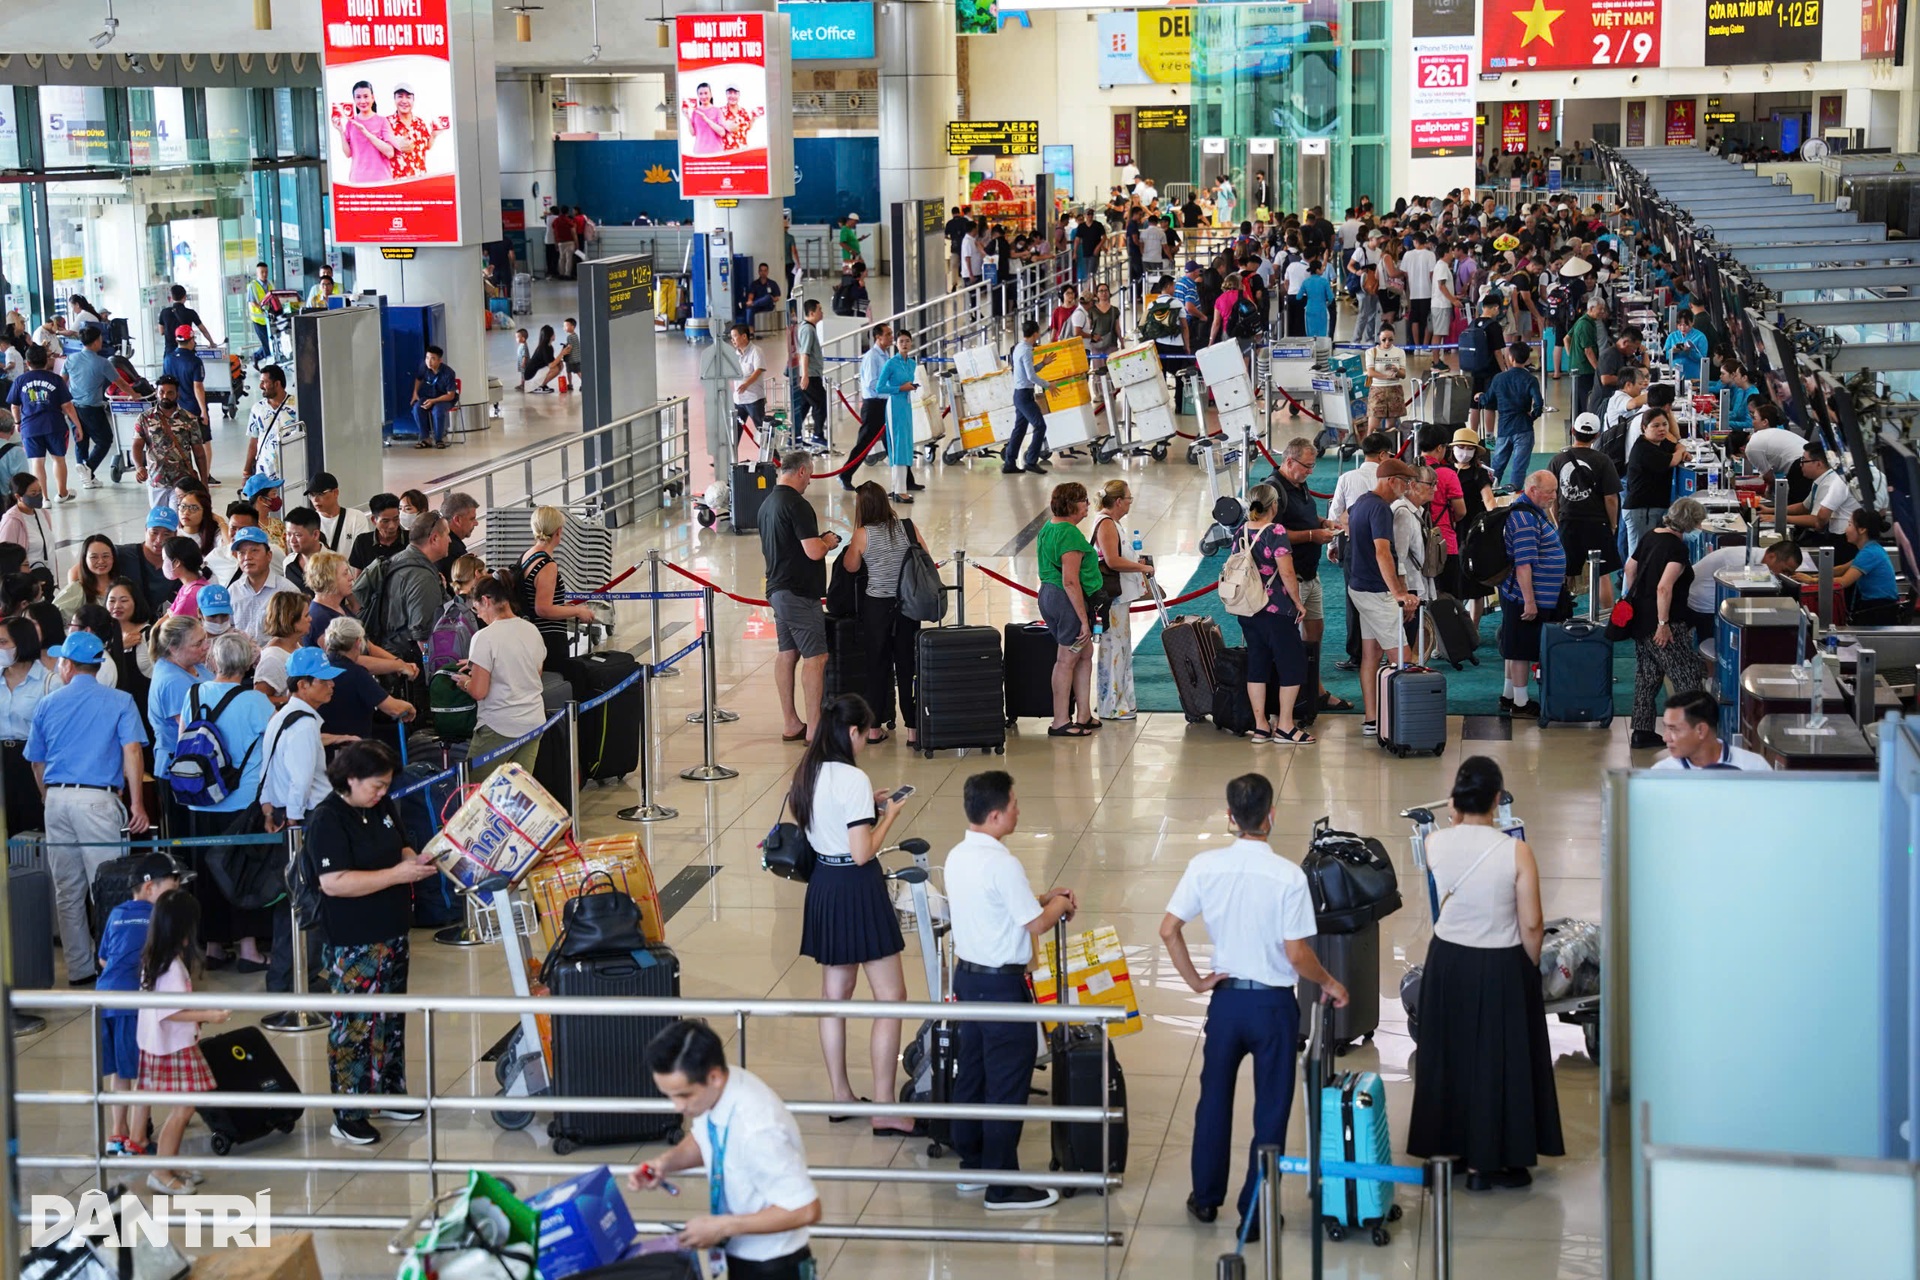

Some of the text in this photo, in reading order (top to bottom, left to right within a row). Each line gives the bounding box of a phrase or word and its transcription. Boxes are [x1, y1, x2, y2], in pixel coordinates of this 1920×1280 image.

[1592, 10, 1654, 30] VIỆT NAM
[1727, 2, 1738, 18] RA
[1758, 0, 1774, 16] BAY
[1778, 3, 1802, 28] 1-12
[374, 24, 413, 50] MẠCH
[416, 24, 444, 46] TW3
[815, 26, 856, 40] Office
[1709, 24, 1745, 36] Boarding Gates
[1592, 30, 1653, 65] 2/9
[1424, 64, 1463, 87] 26.1
[50, 114, 65, 130] 5
